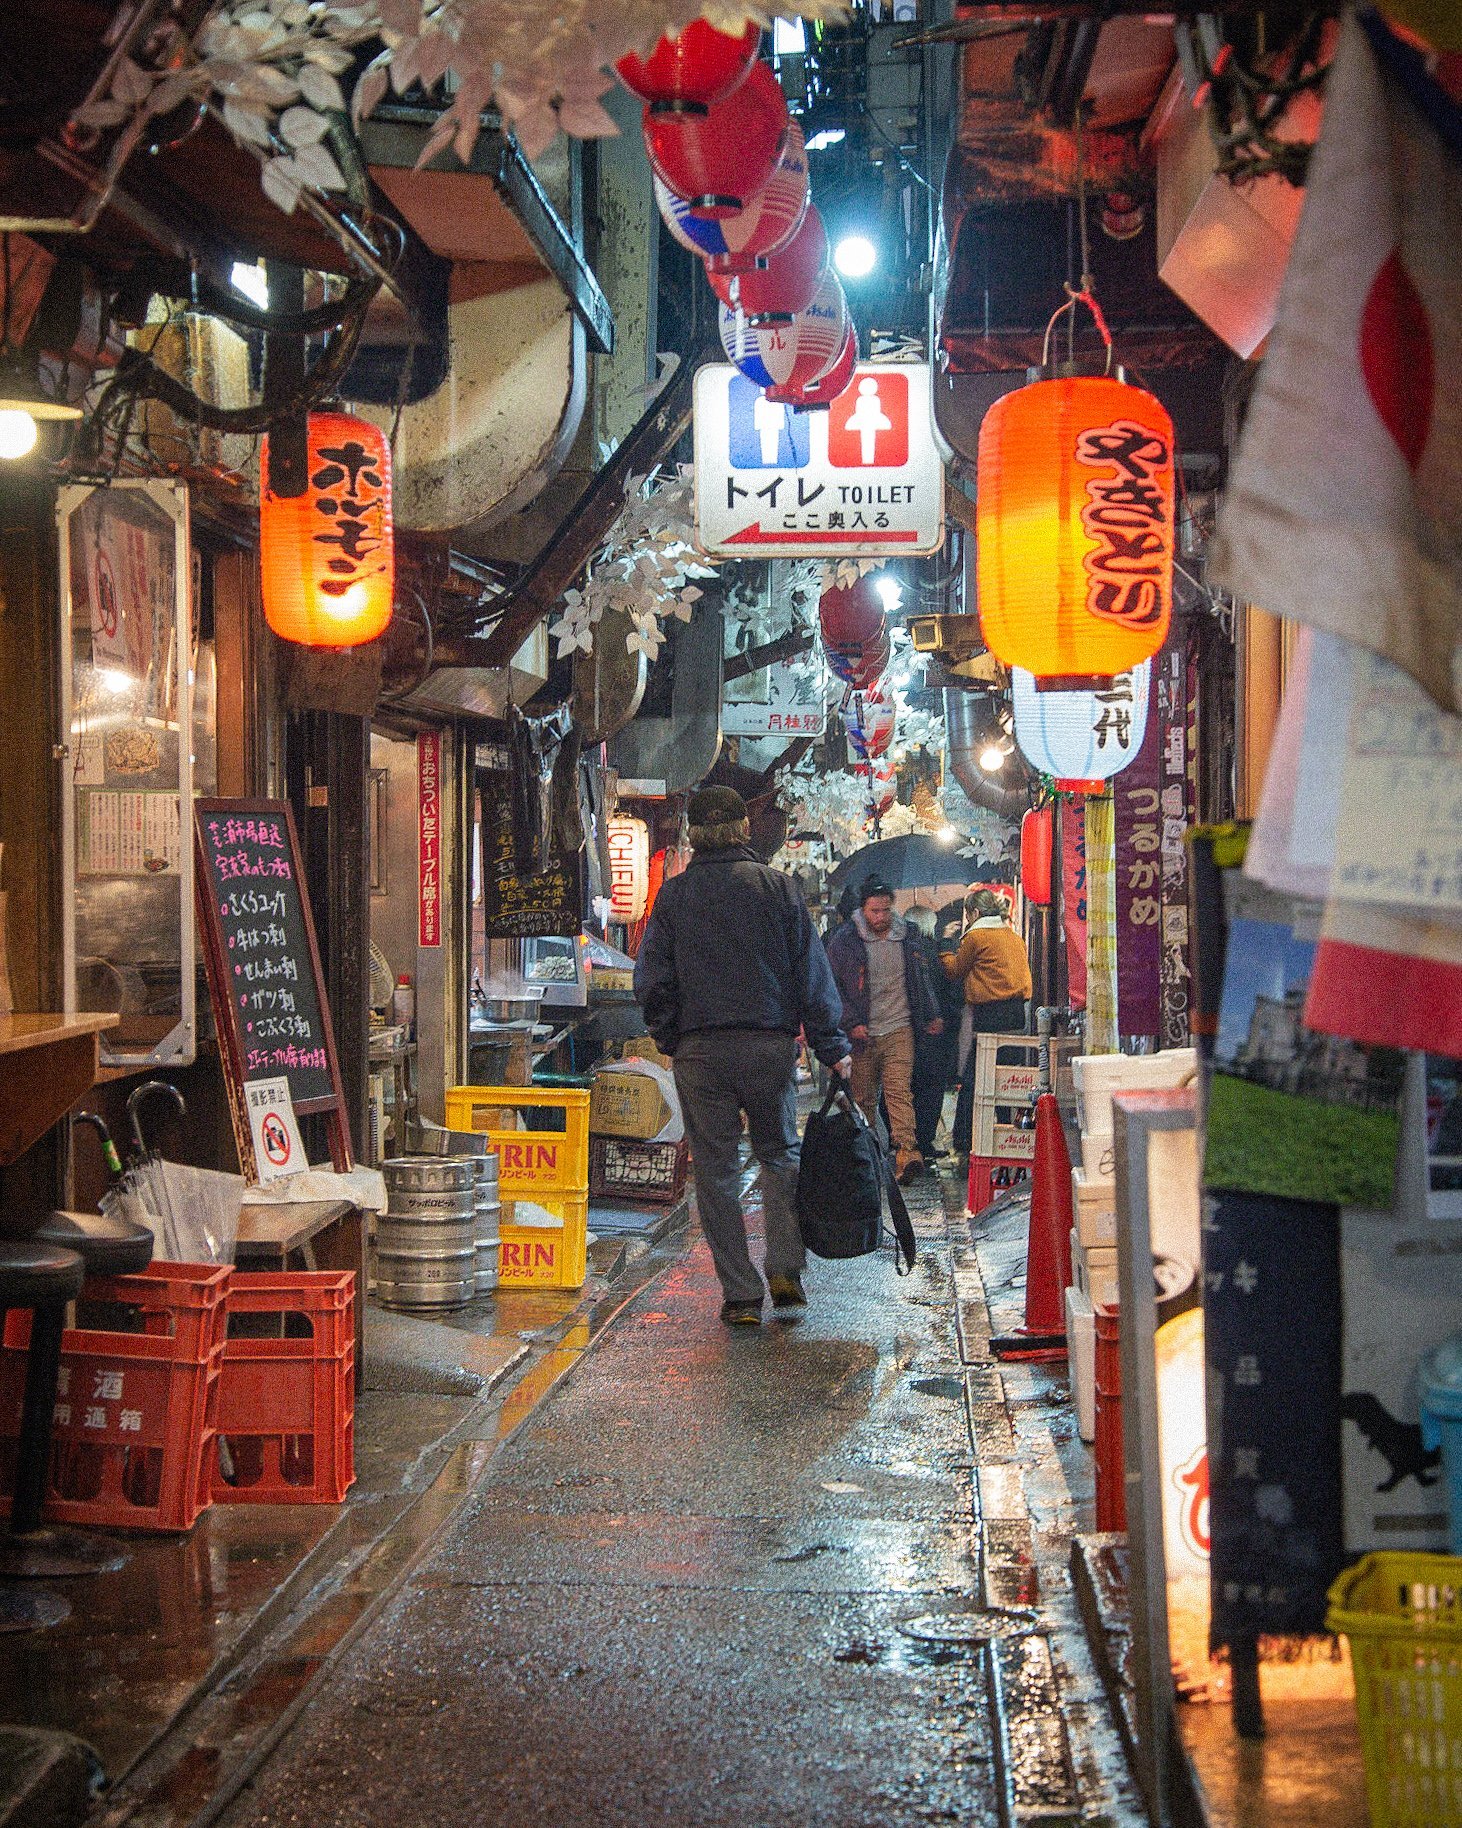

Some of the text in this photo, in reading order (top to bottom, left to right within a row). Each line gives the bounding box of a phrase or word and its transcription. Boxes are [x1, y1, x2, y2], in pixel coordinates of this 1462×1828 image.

[727, 476, 916, 509] トイレ TOILET
[311, 441, 386, 596] ホルモン
[782, 511, 890, 529] ここ奥入る
[1127, 786, 1160, 926] つるかめ
[607, 826, 633, 915] ICHIFUJI
[229, 889, 286, 918] さくらユッケ
[244, 954, 298, 981] せんまい刺
[251, 987, 296, 1012] ガツ刺
[256, 1014, 311, 1038] こぶくろ刺
[1007, 1074, 1033, 1085] Asahi
[250, 1087, 286, 1108] 撮影禁止
[1004, 1134, 1031, 1144] Asahi
[487, 1144, 557, 1169] RIN
[499, 1170, 537, 1180] リンビール
[408, 1198, 456, 1209] サッポロビール
[501, 1243, 554, 1267] RIN
[53, 1403, 143, 1432] 用通箱
